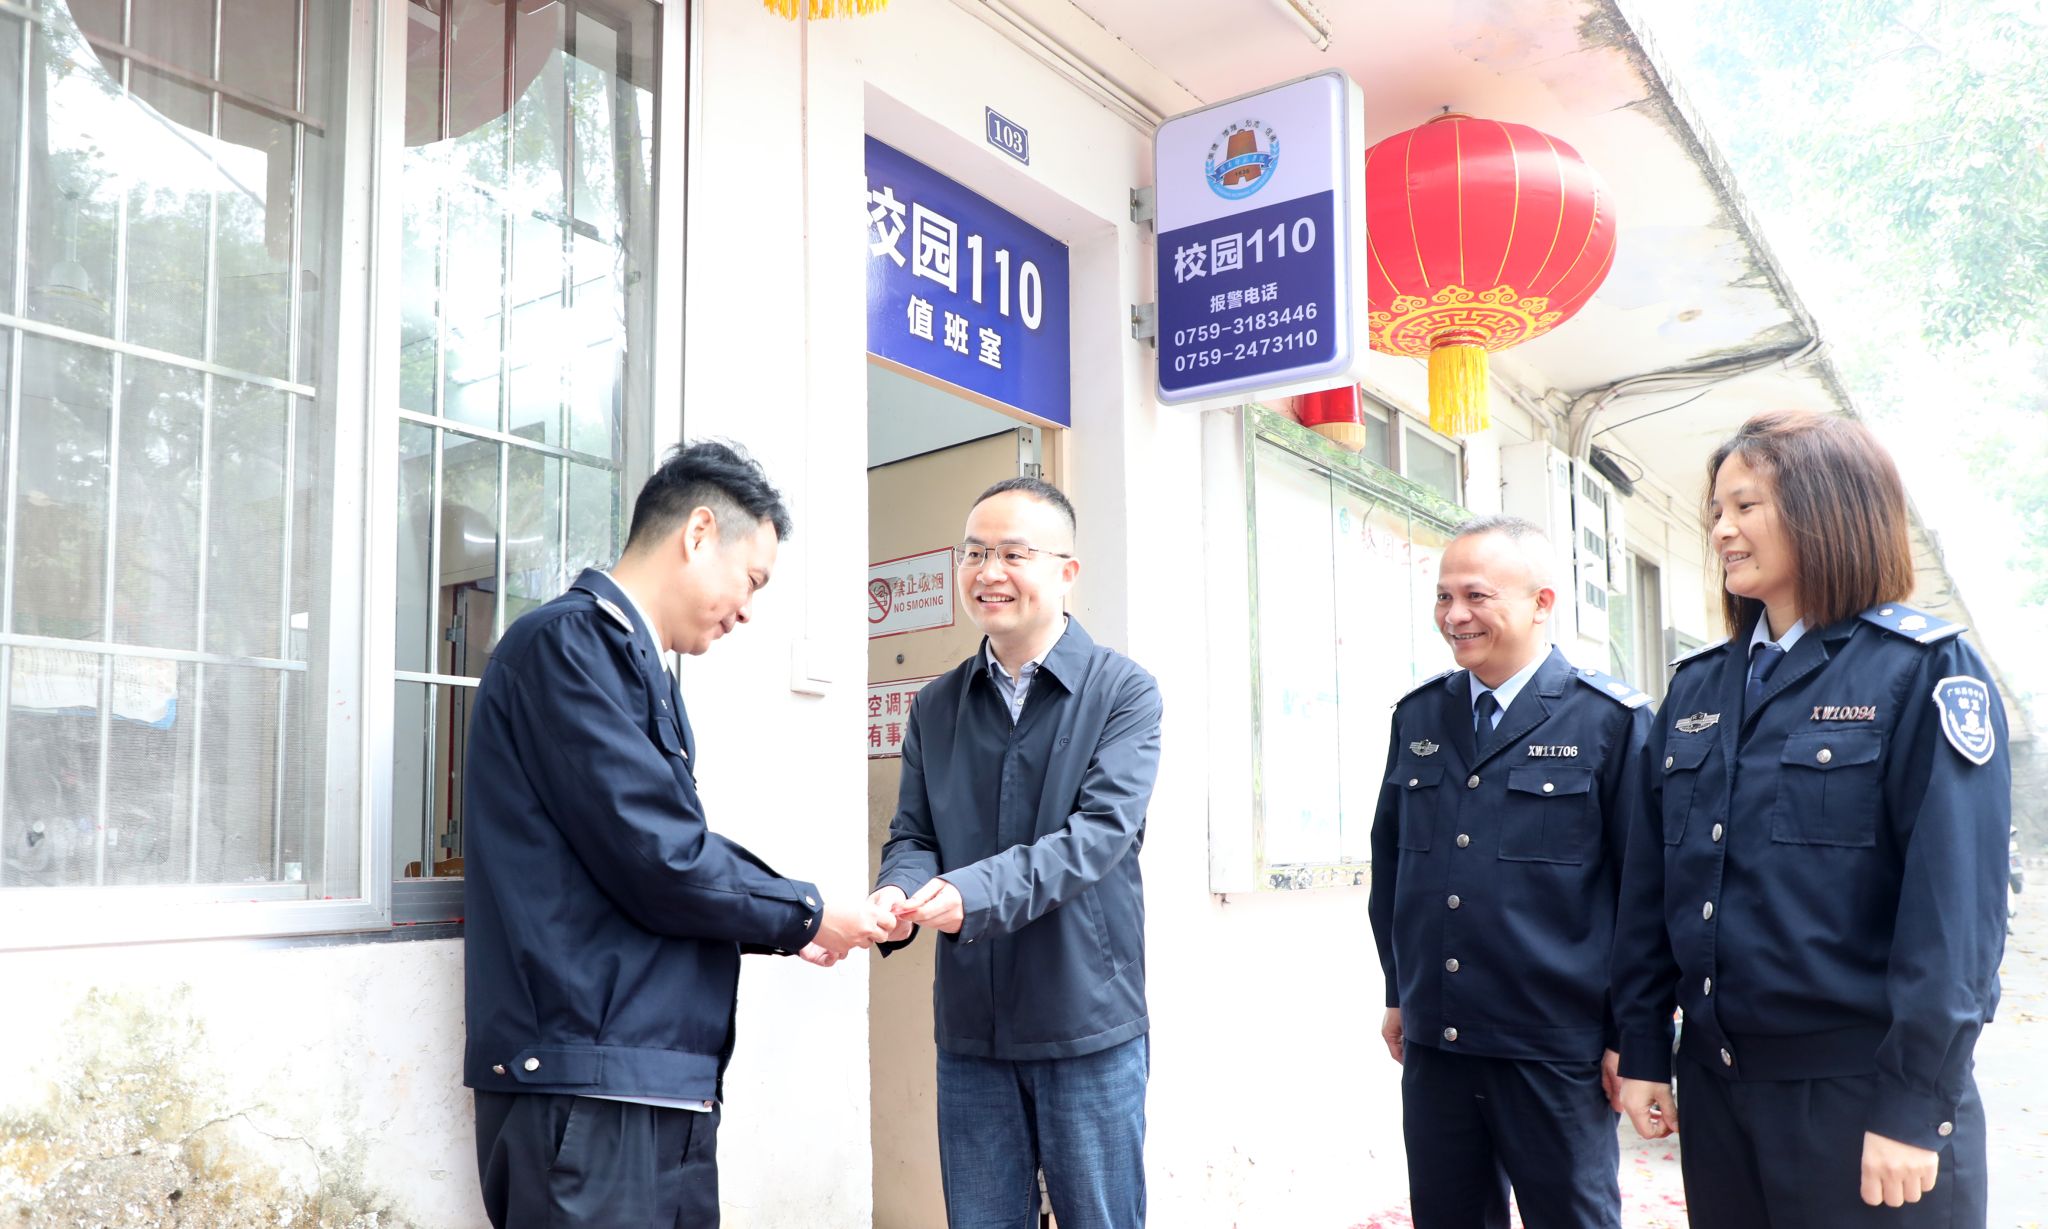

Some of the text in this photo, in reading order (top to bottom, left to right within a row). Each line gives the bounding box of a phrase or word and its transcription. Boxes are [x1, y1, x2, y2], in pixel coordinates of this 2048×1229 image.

[993, 119, 1024, 154] 103
[866, 176, 1043, 331] 校园110
[1174, 217, 1317, 284] 校园110
[1209, 282, 1279, 314] 报警电话
[906, 294, 1003, 370] 值班室
[1173, 302, 1318, 347] 0759-3183446
[1173, 328, 1319, 373] 0759-2473110
[893, 572, 944, 598] 禁止吸烟
[893, 595, 944, 613] NO SMOKING
[867, 721, 908, 748] 有事
[1527, 745, 1578, 758] XW11706
